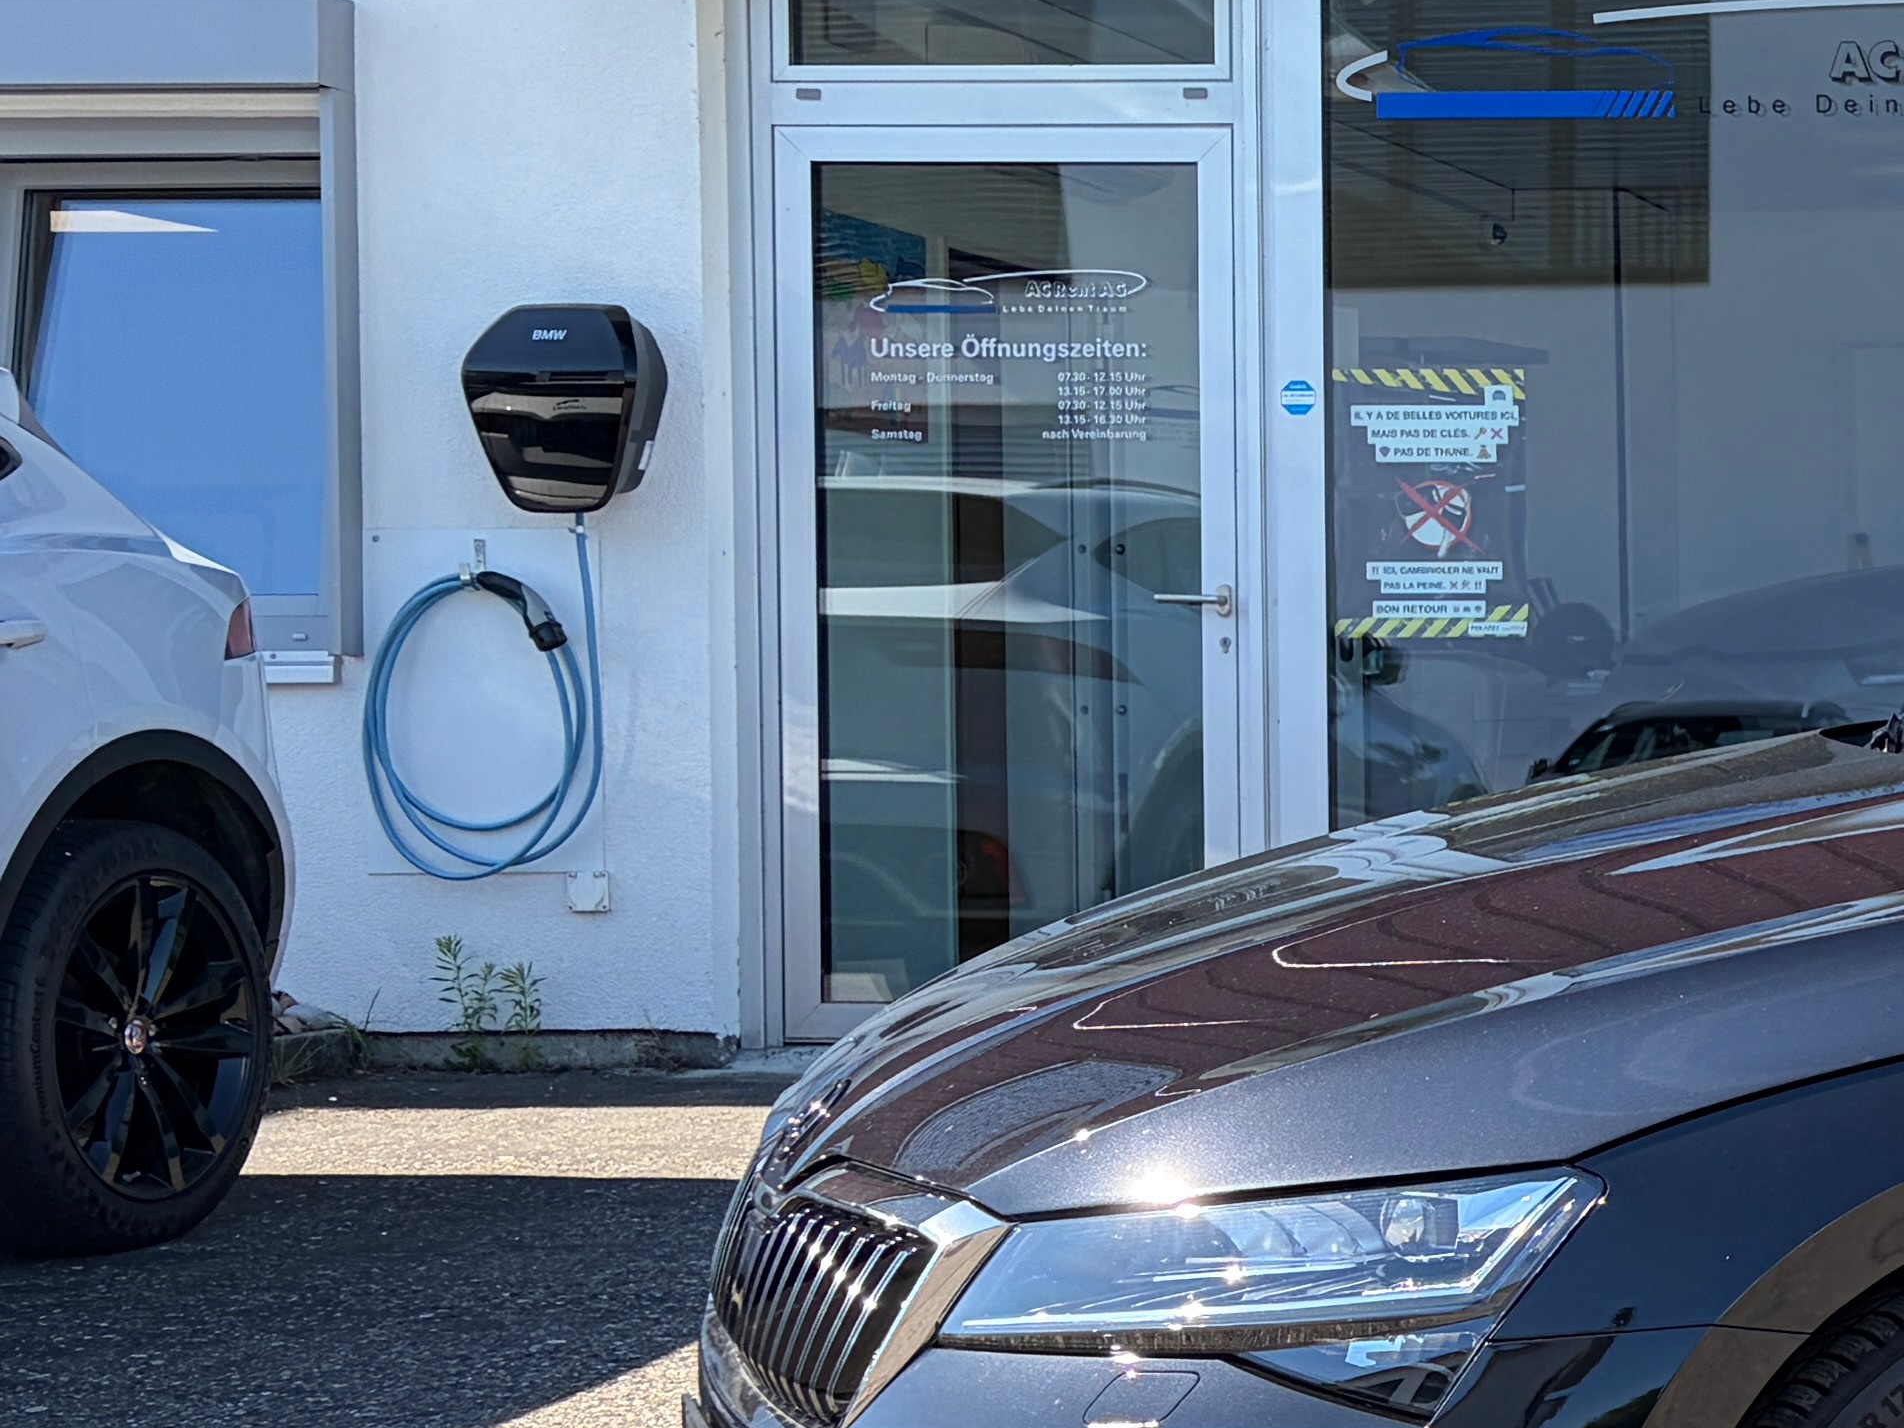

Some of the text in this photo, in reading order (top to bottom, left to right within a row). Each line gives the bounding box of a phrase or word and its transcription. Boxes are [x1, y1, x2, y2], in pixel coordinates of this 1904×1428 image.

[1829, 39, 1902, 83] AC
[1699, 93, 1788, 115] Lebe
[532, 329, 568, 341] BMW
[870, 333, 1147, 362] Unsere Öffnungszeiten:
